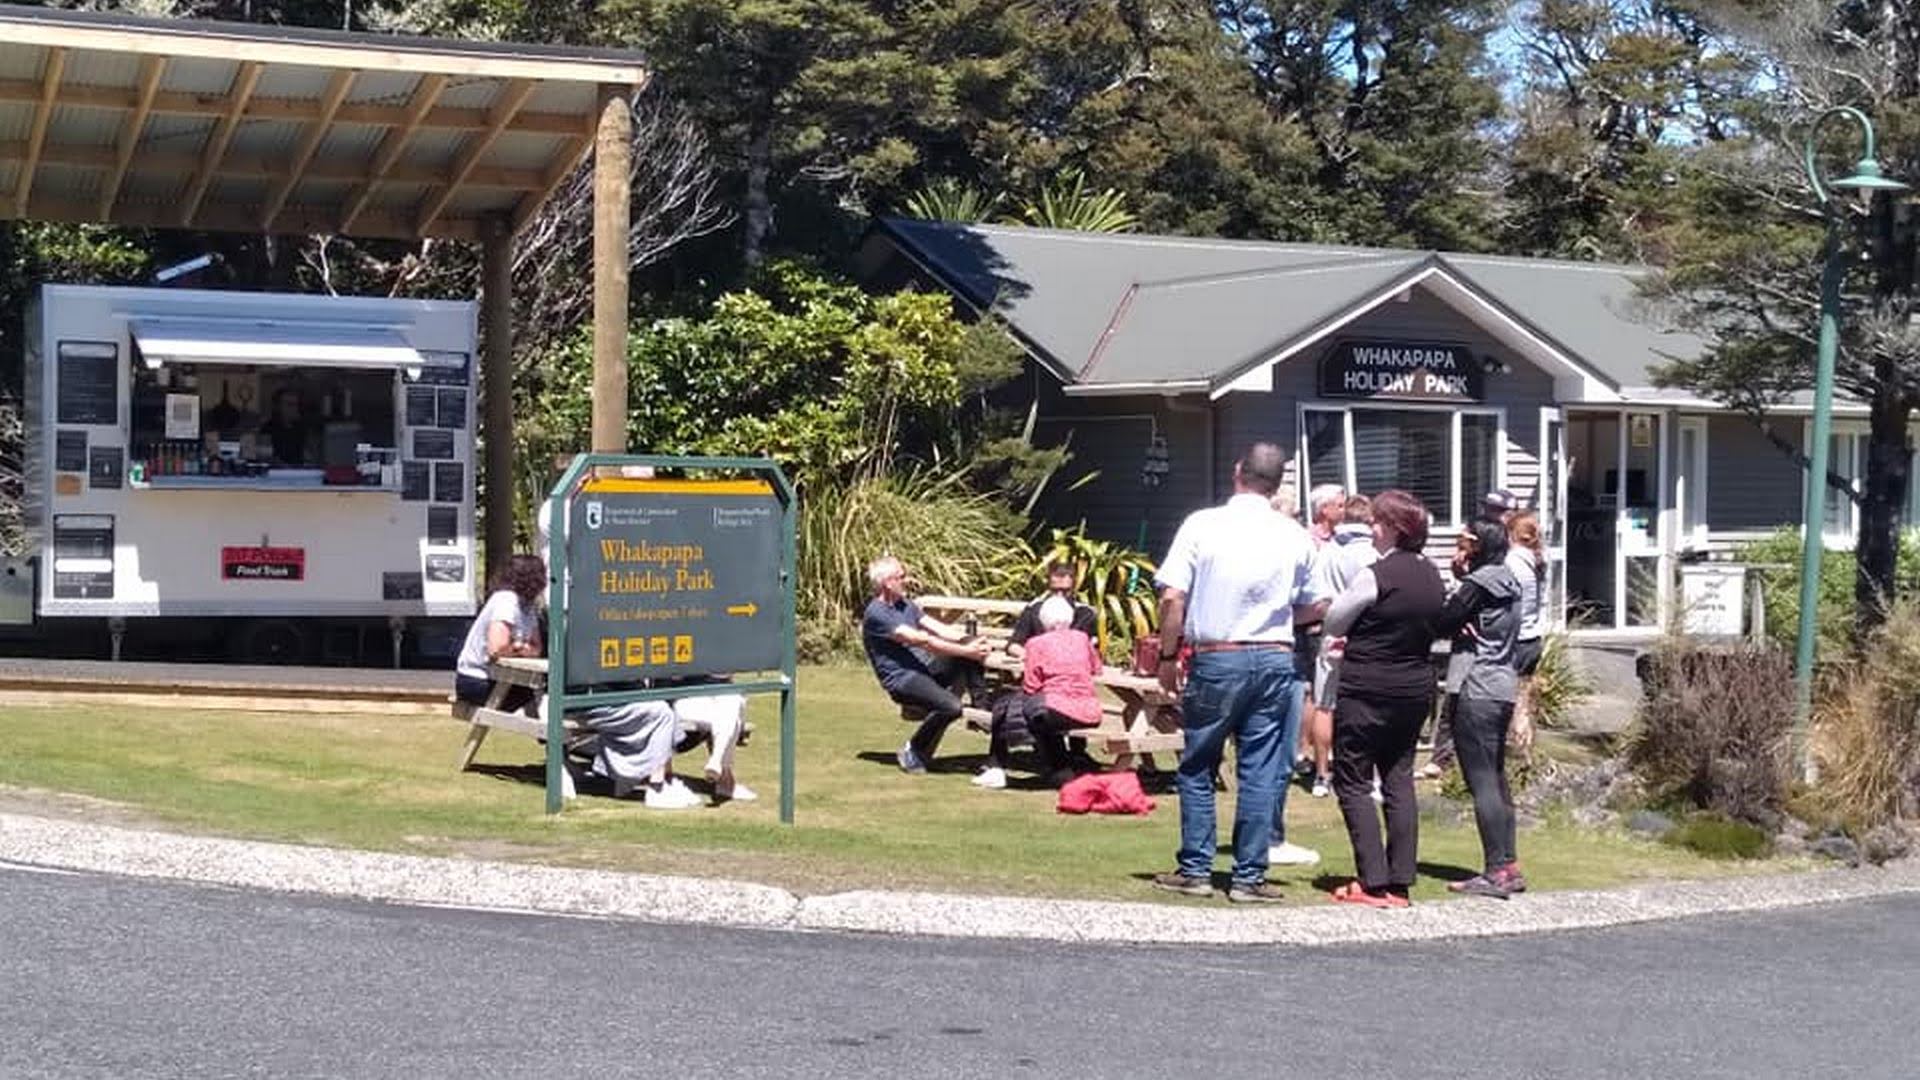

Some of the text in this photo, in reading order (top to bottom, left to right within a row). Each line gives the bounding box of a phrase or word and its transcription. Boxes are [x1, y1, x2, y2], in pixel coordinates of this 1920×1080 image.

[1353, 347, 1455, 368] WHAKAPAPA
[1344, 371, 1467, 393] HOLIDAY PARK
[600, 539, 703, 568] Whakapapa
[236, 565, 289, 577] Food Truck
[600, 567, 714, 599] Holiday Park
